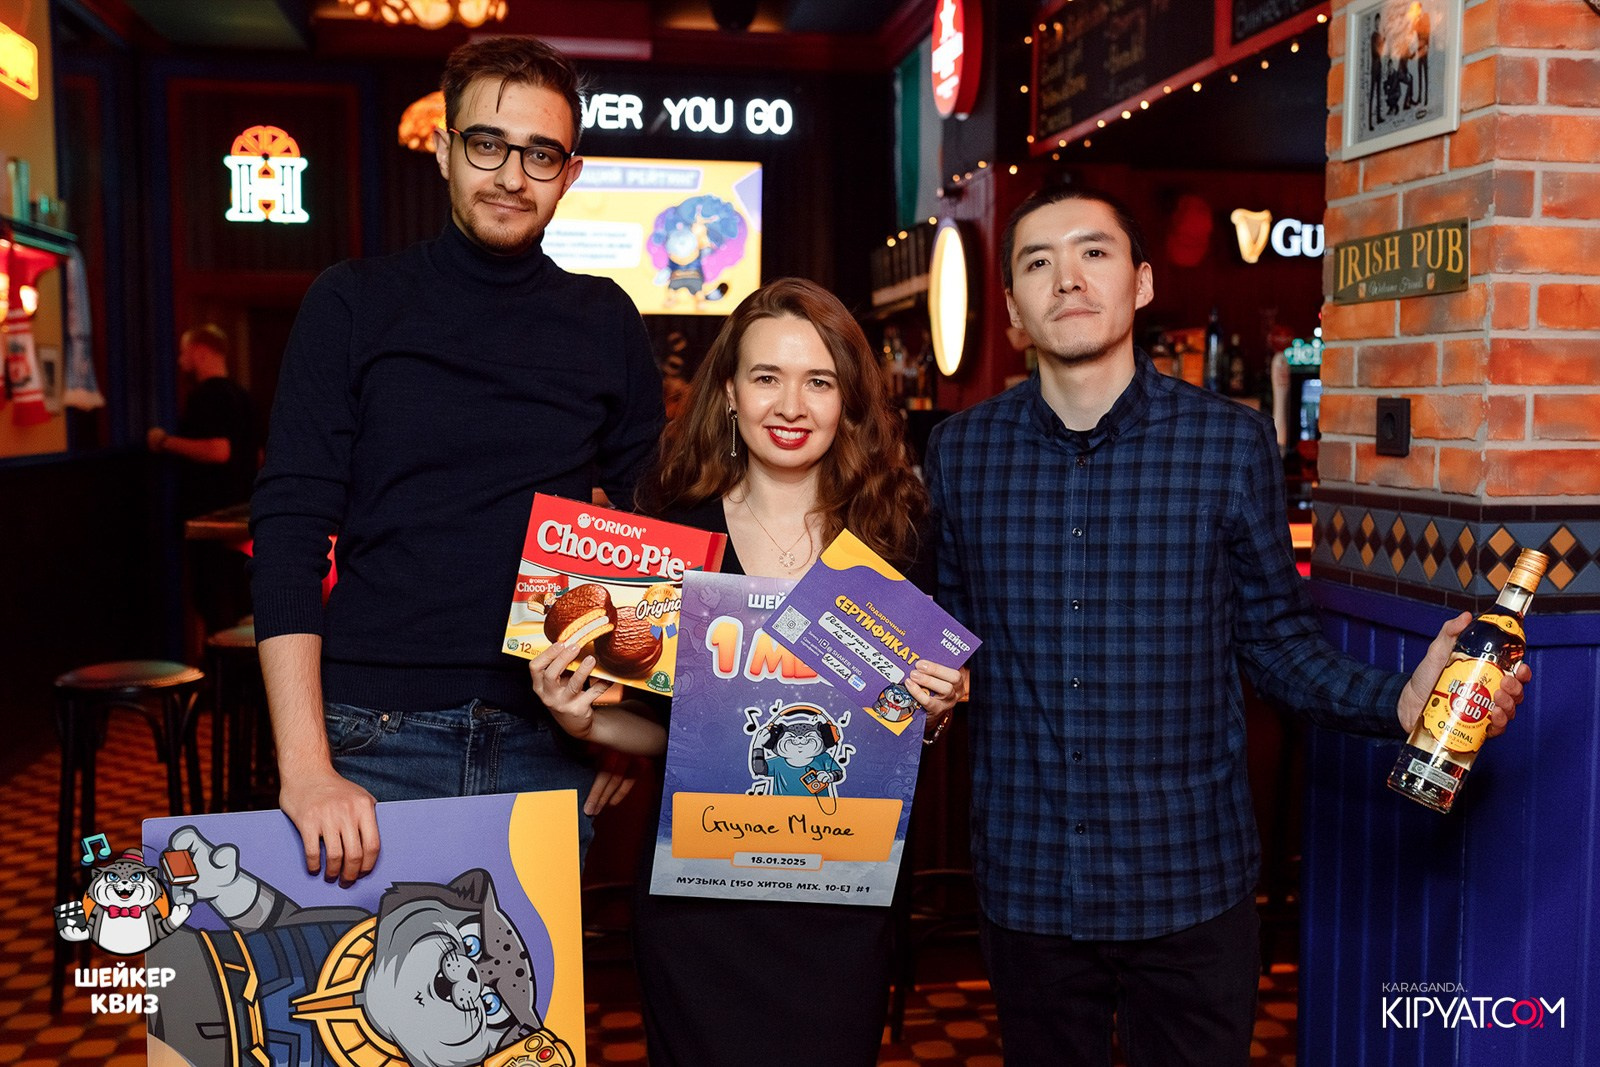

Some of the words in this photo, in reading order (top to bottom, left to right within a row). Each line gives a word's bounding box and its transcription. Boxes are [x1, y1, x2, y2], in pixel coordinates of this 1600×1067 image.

[580, 94, 643, 130] VER
[663, 97, 734, 134] YOU
[745, 98, 794, 136] GO
[1271, 217, 1325, 258] GU
[1337, 235, 1400, 292] IRISH
[1411, 227, 1464, 274] PUB
[636, 597, 682, 620] Origina
[748, 592, 787, 610] ШЕЙ
[835, 595, 920, 666] СЕРТИФИКАТ
[866, 601, 906, 637] Подарочный
[1505, 620, 1513, 628] 3
[520, 642, 531, 654] 12
[709, 619, 741, 676] 1
[940, 638, 961, 656] КВИЗ
[942, 628, 970, 652] ШЕЙКЕР
[1448, 679, 1496, 712] Havana
[1452, 696, 1482, 721] Club
[751, 856, 806, 866] 18.01.2025
[676, 876, 727, 887] МУЗЫКА
[730, 879, 753, 888] [150
[757, 880, 793, 889] ХИТОВ
